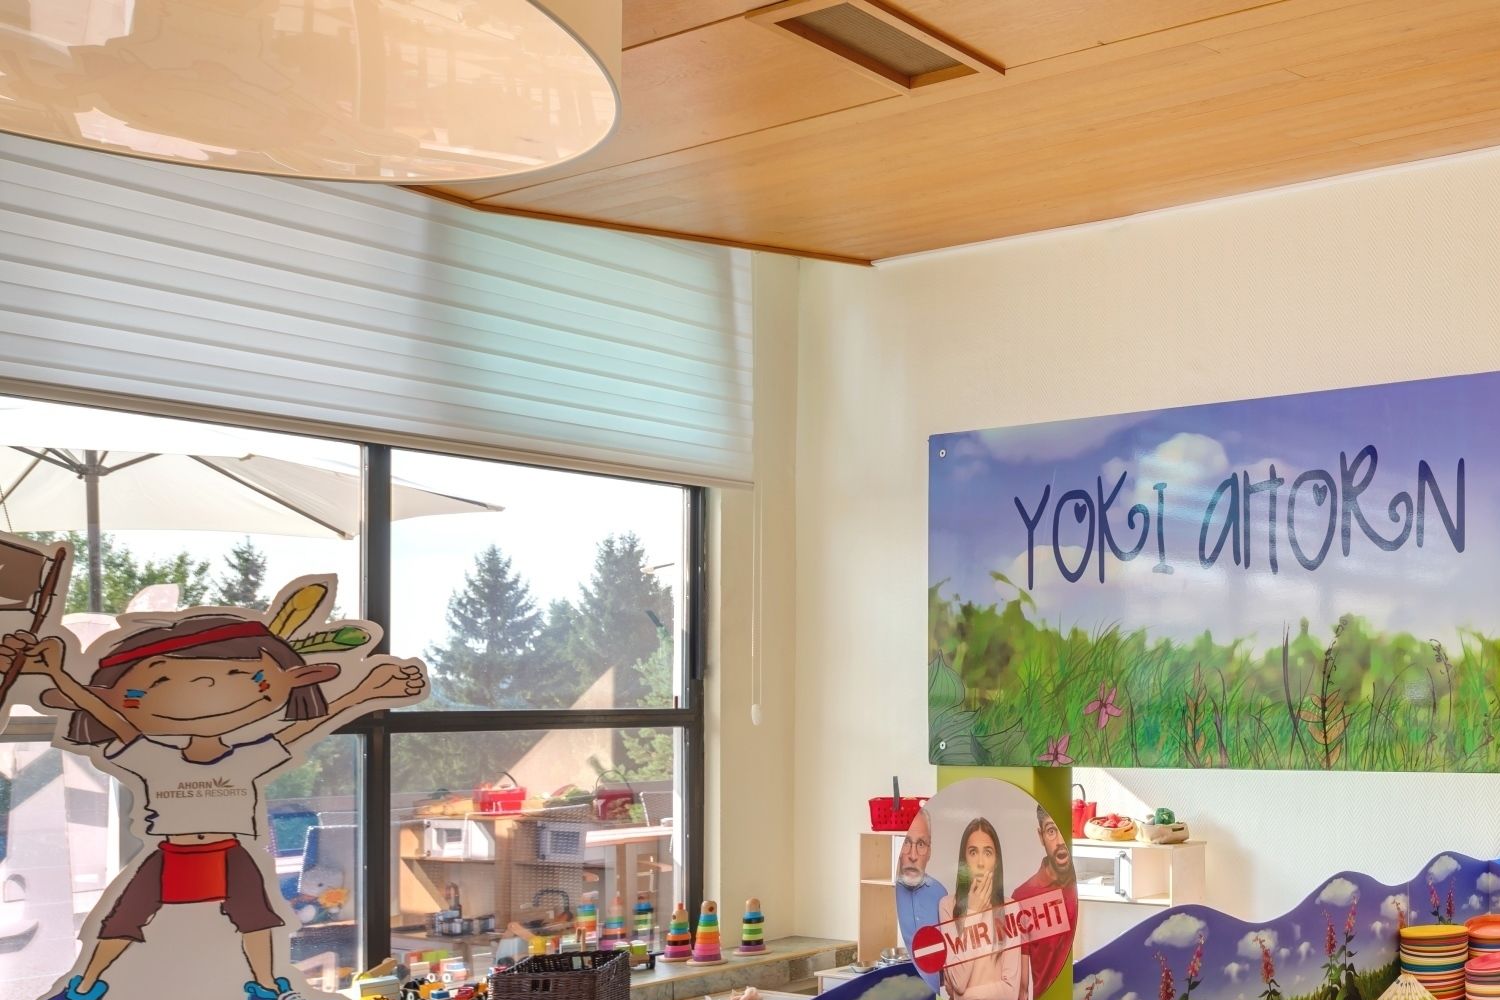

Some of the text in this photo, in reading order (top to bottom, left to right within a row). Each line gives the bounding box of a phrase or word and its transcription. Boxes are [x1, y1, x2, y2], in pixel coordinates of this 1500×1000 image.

[1013, 470, 1174, 591] YOKI
[156, 790, 194, 799] HOTELS
[204, 788, 248, 797] RESORTS
[177, 781, 213, 790] AHORN
[944, 899, 1063, 955] WIR NICHT
